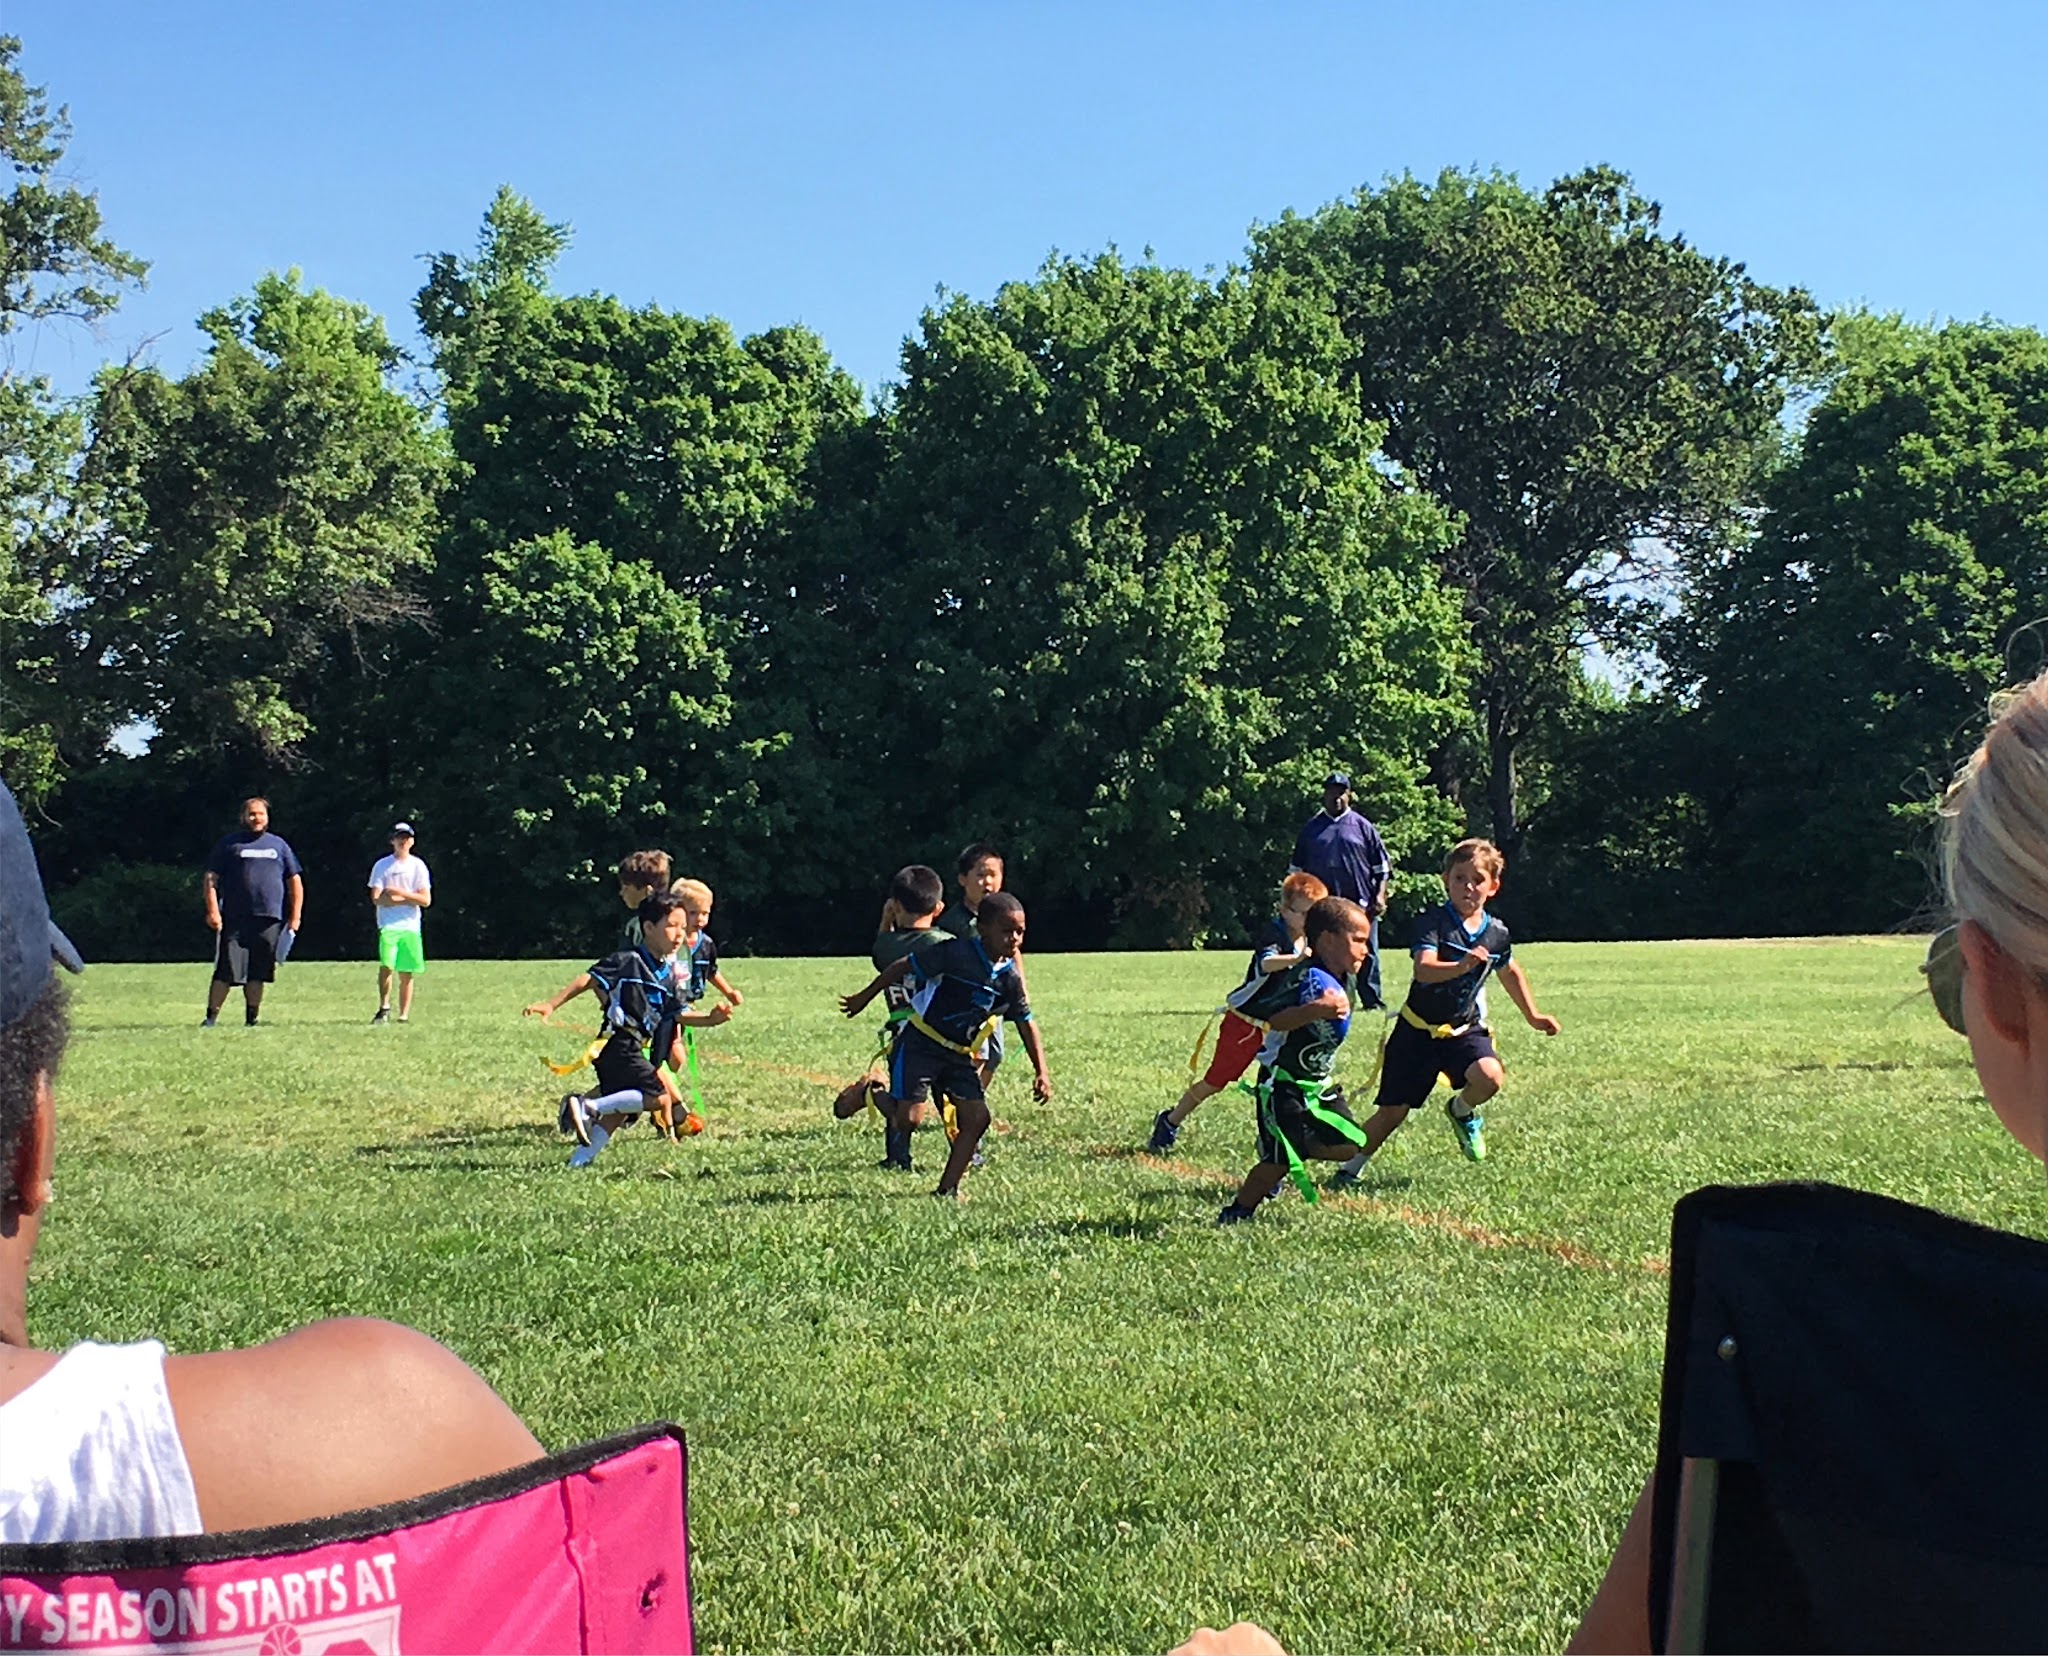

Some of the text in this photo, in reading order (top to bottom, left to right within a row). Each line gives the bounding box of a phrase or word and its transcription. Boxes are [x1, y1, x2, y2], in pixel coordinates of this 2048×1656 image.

[41, 1586, 207, 1644] SEASON
[216, 1563, 348, 1632] STARTS
[355, 1552, 397, 1607] AT
